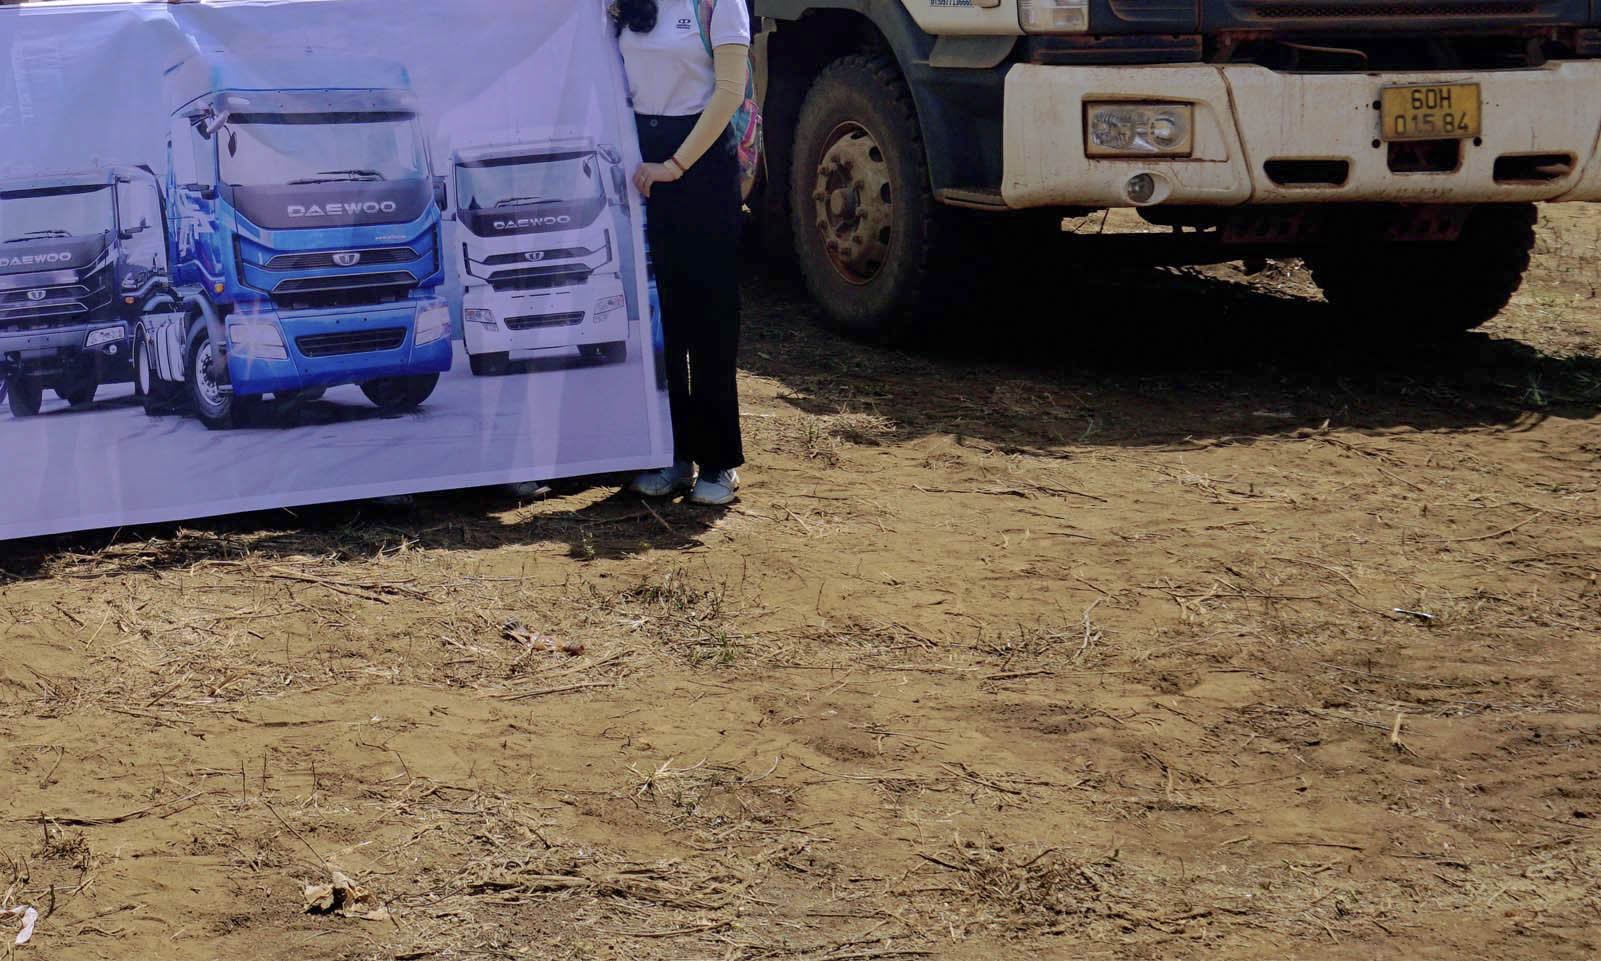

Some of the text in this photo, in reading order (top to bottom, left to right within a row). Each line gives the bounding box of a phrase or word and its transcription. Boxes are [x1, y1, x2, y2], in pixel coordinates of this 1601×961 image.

[1411, 87, 1452, 110] 60H
[287, 201, 396, 217] DAEWOO
[493, 215, 571, 230] DAEWOO
